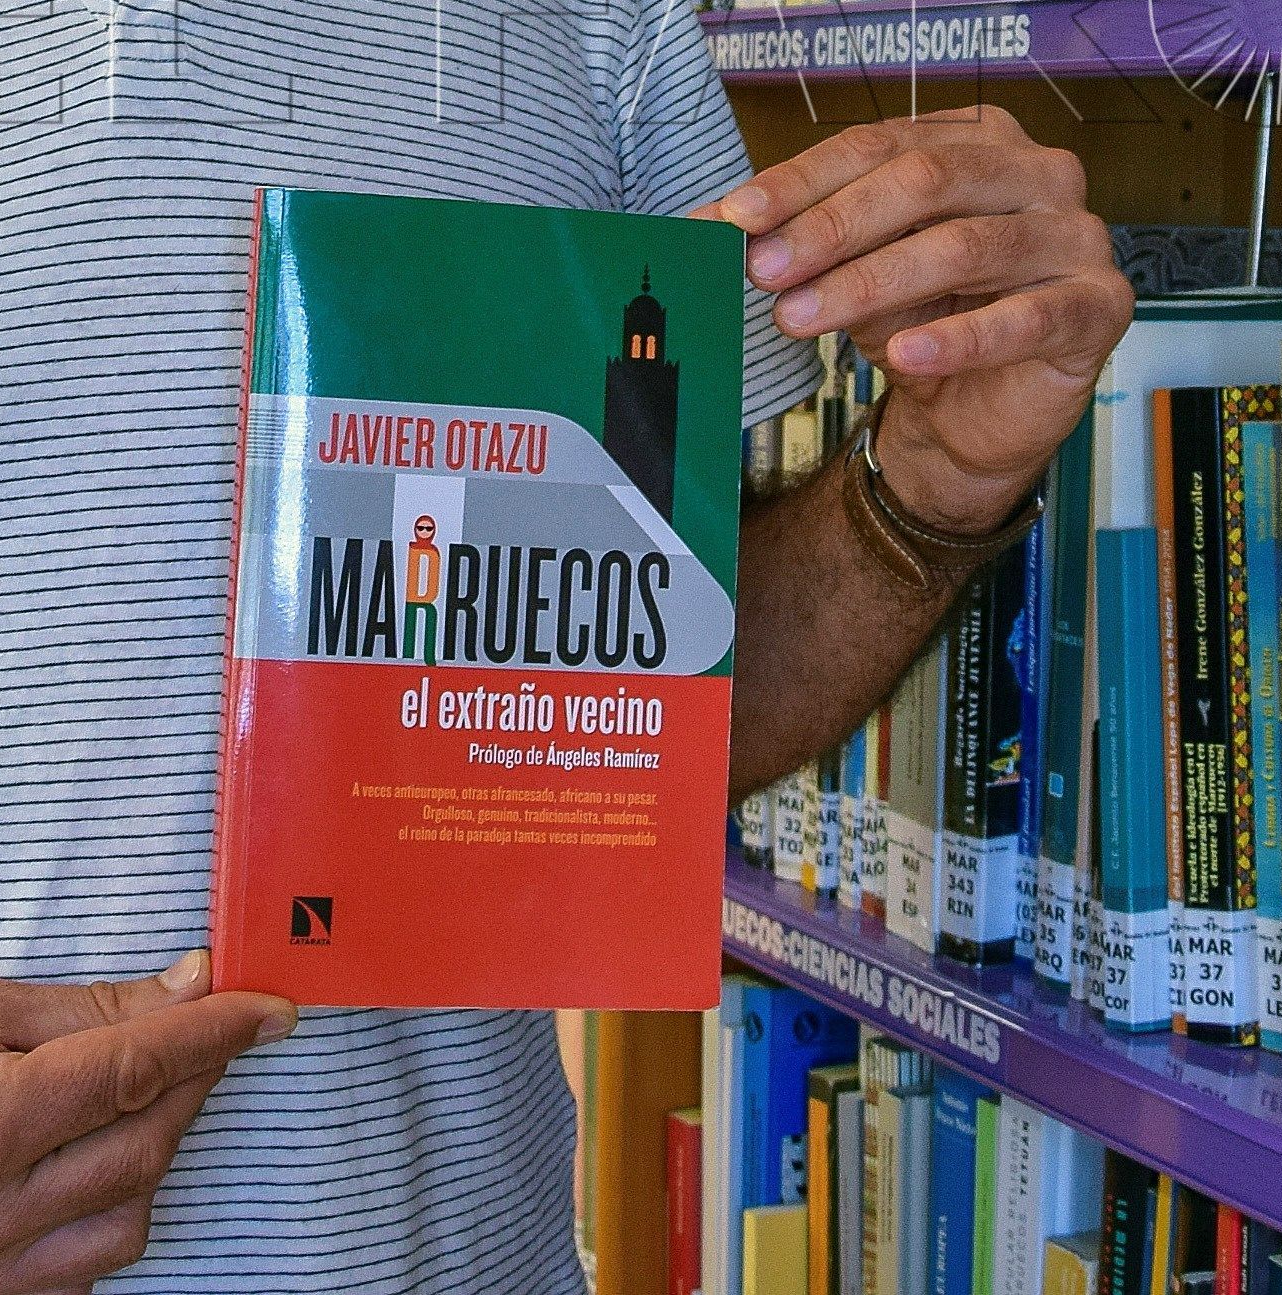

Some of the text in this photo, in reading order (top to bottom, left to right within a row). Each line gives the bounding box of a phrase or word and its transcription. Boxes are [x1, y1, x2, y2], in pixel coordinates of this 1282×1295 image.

[815, 23, 911, 64] CIENCIAS
[917, 14, 1030, 59] SOCIALES
[319, 412, 547, 475] JAVIER OTAZU
[307, 535, 671, 669] MARRUECOS
[401, 677, 663, 736] el extraño vecino
[469, 741, 659, 770] Prólogo de Ángeles Ramírez
[352, 782, 657, 807] A veces antieuropeo, otras afrancesado, africano a su pesar.
[423, 805, 657, 826] Orgulloso, genuino, tradicionalista, moderno...
[398, 826, 656, 848] el reino de la paradoja tantas veces incomprendido
[1188, 936, 1233, 957] MAR
[1200, 962, 1224, 981] 37
[1189, 988, 1234, 1008] GON
[887, 977, 1000, 1064] SOCIALES
